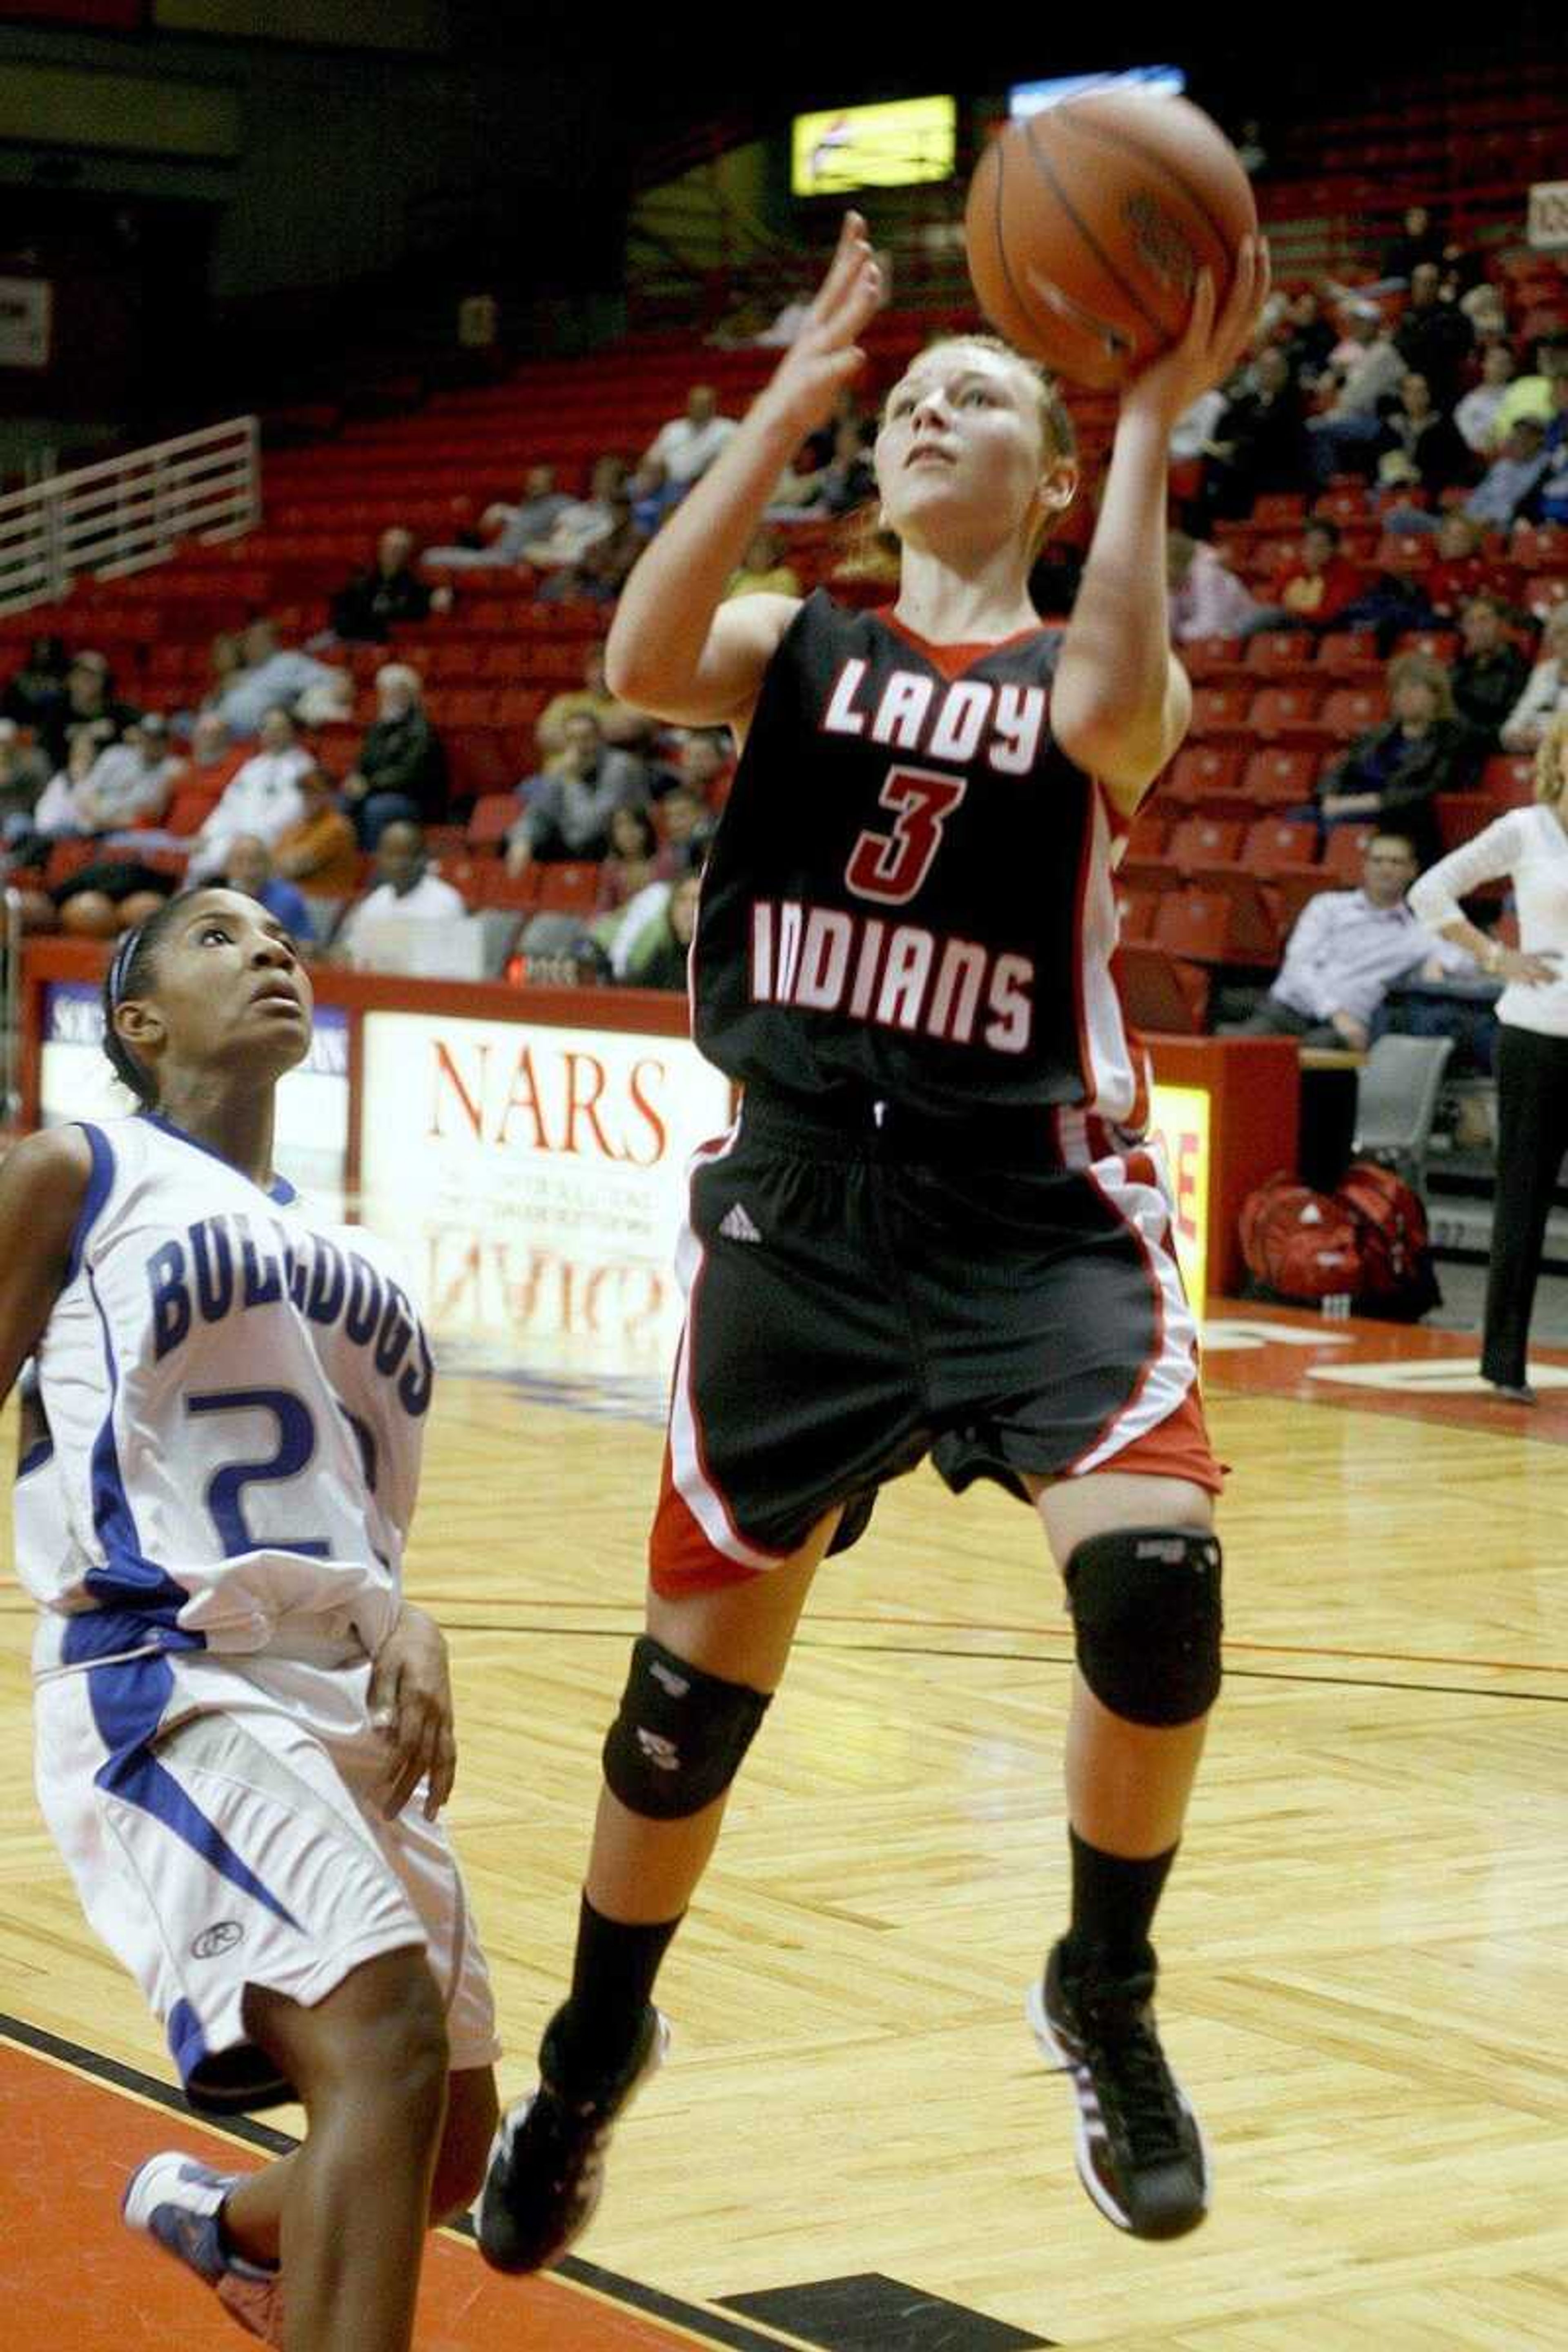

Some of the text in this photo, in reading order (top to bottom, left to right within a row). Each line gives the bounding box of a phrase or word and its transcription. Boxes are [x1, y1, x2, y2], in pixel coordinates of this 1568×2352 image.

[824, 658, 1045, 775] LADY
[844, 764, 967, 905] 3
[753, 902, 1034, 1054] INDIANS
[428, 1036, 667, 1167] NARS
[147, 1214, 433, 1416] BULLDOGS
